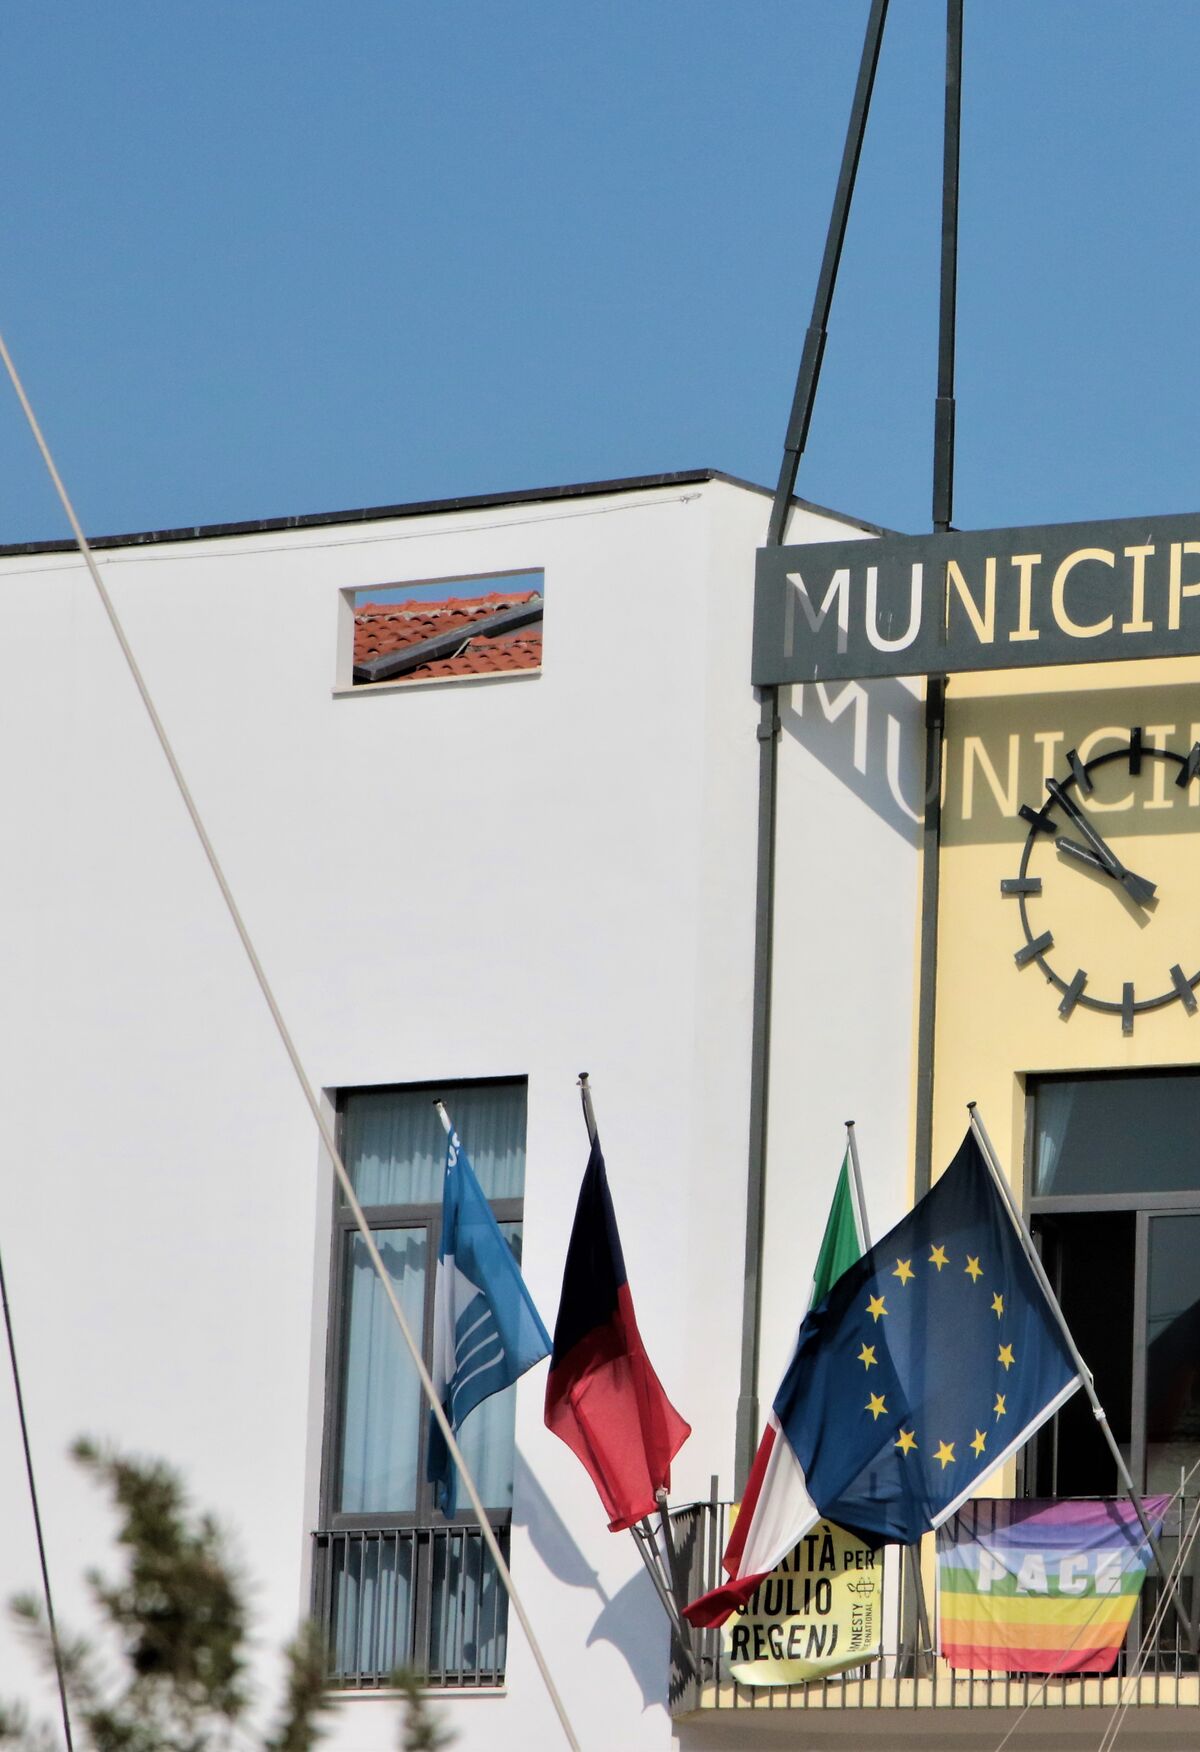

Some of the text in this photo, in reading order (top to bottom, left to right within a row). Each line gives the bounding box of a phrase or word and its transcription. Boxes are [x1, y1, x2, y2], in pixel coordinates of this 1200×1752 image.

[844, 1550, 875, 1571] PER
[977, 1551, 1122, 1595] PACE
[730, 1623, 839, 1662] REGENI
